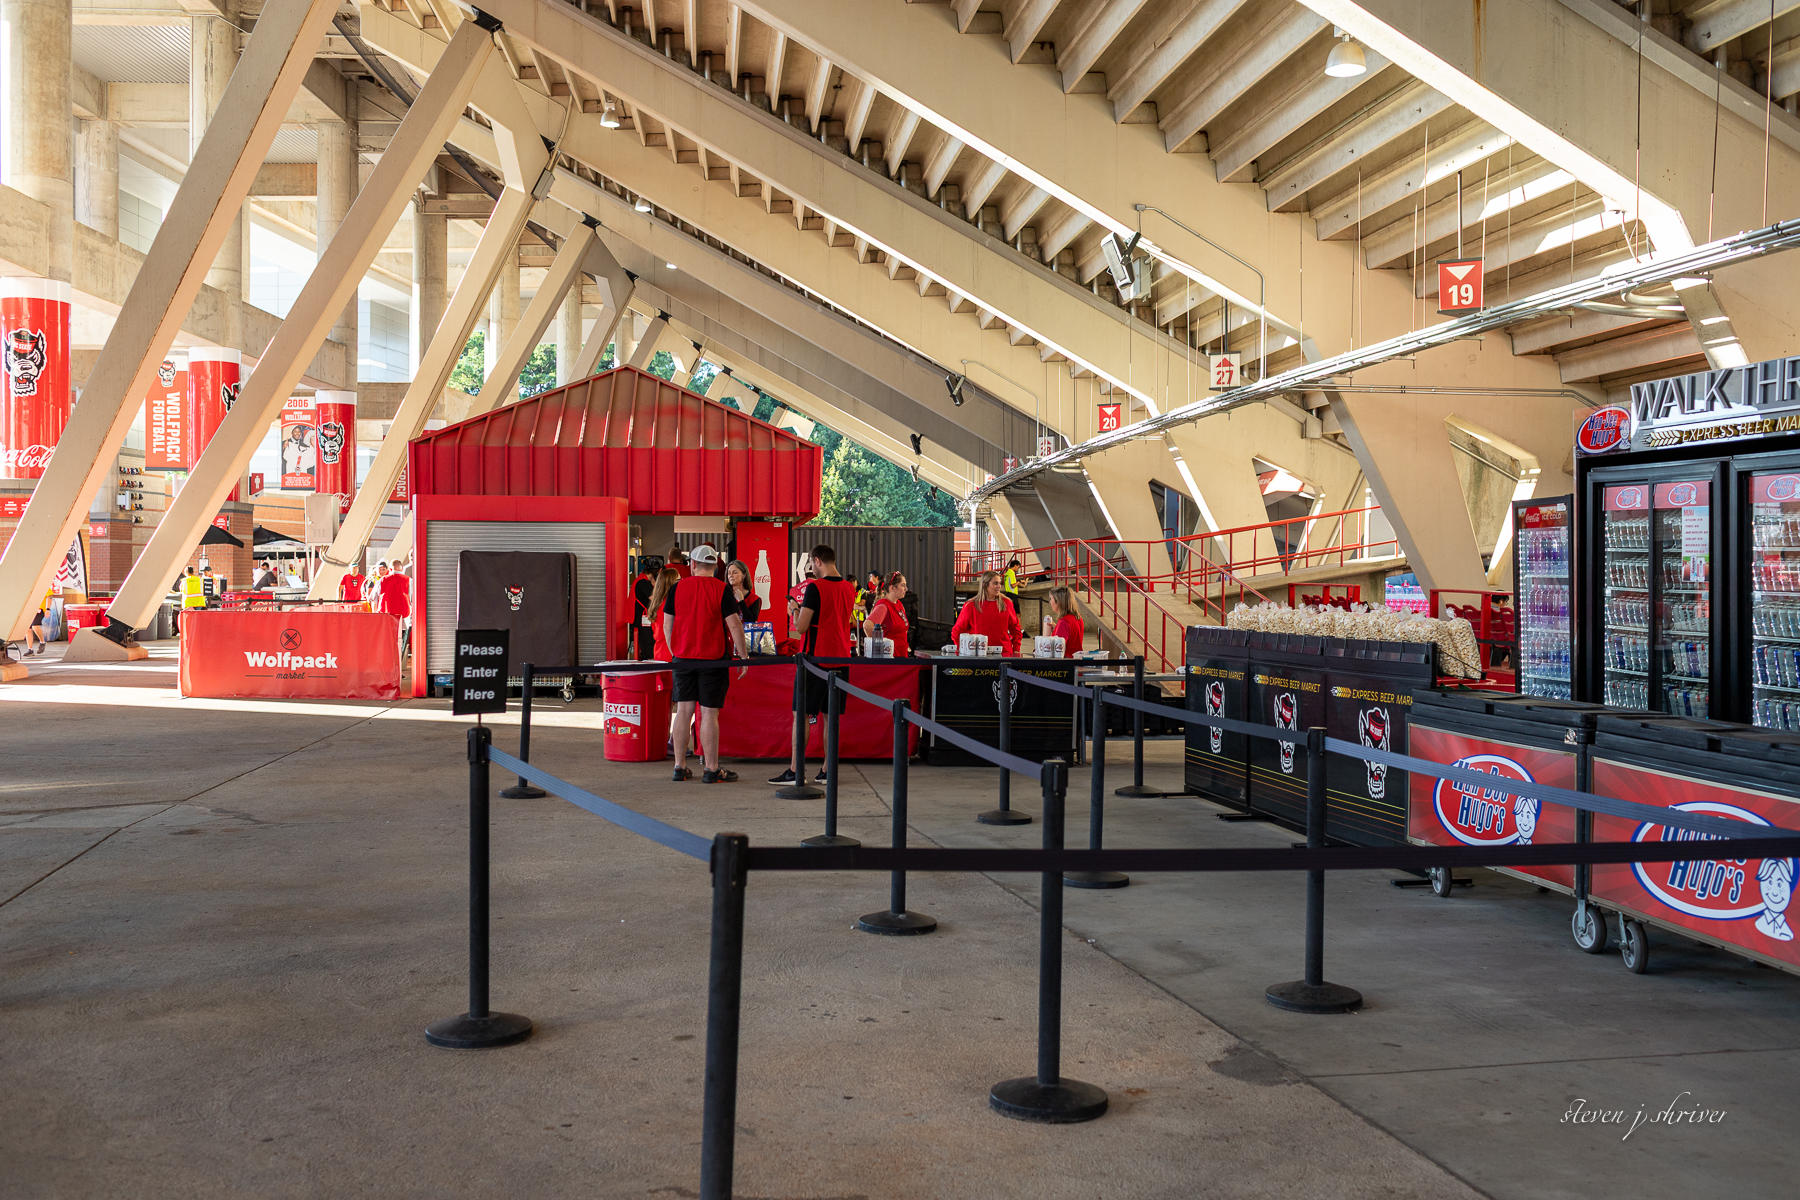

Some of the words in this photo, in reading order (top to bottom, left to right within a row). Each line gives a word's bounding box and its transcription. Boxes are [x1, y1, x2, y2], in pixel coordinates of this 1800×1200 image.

[1448, 283, 1474, 306] 19
[1216, 369, 1234, 385] 27
[287, 399, 309, 408] 2006
[1630, 369, 1735, 422] WALK
[152, 400, 165, 454] FOOTBALL
[166, 391, 181, 463] WOLFPACK
[1102, 417, 1117, 429] 20
[1587, 411, 1618, 431] Han-Dee
[1590, 429, 1616, 447] Hugo's
[1682, 422, 1735, 443] EXPRESS
[1739, 418, 1773, 436] BEER
[460, 644, 504, 656] Please
[243, 651, 338, 671] Wolfpack
[275, 672, 306, 680] market
[463, 667, 498, 678] Enter
[974, 668, 1000, 676] EXPRE
[1035, 670, 1069, 678] MARKET
[1219, 669, 1229, 678] BEER
[1228, 671, 1245, 681] MARKET
[1269, 676, 1289, 688] EXPRESS
[1289, 679, 1300, 690] BEER
[1301, 681, 1321, 693] MARKET
[463, 688, 496, 700] Here
[1352, 689, 1379, 702] EXPRESS
[1379, 692, 1395, 704] BEER
[1457, 793, 1506, 834] Hugo's
